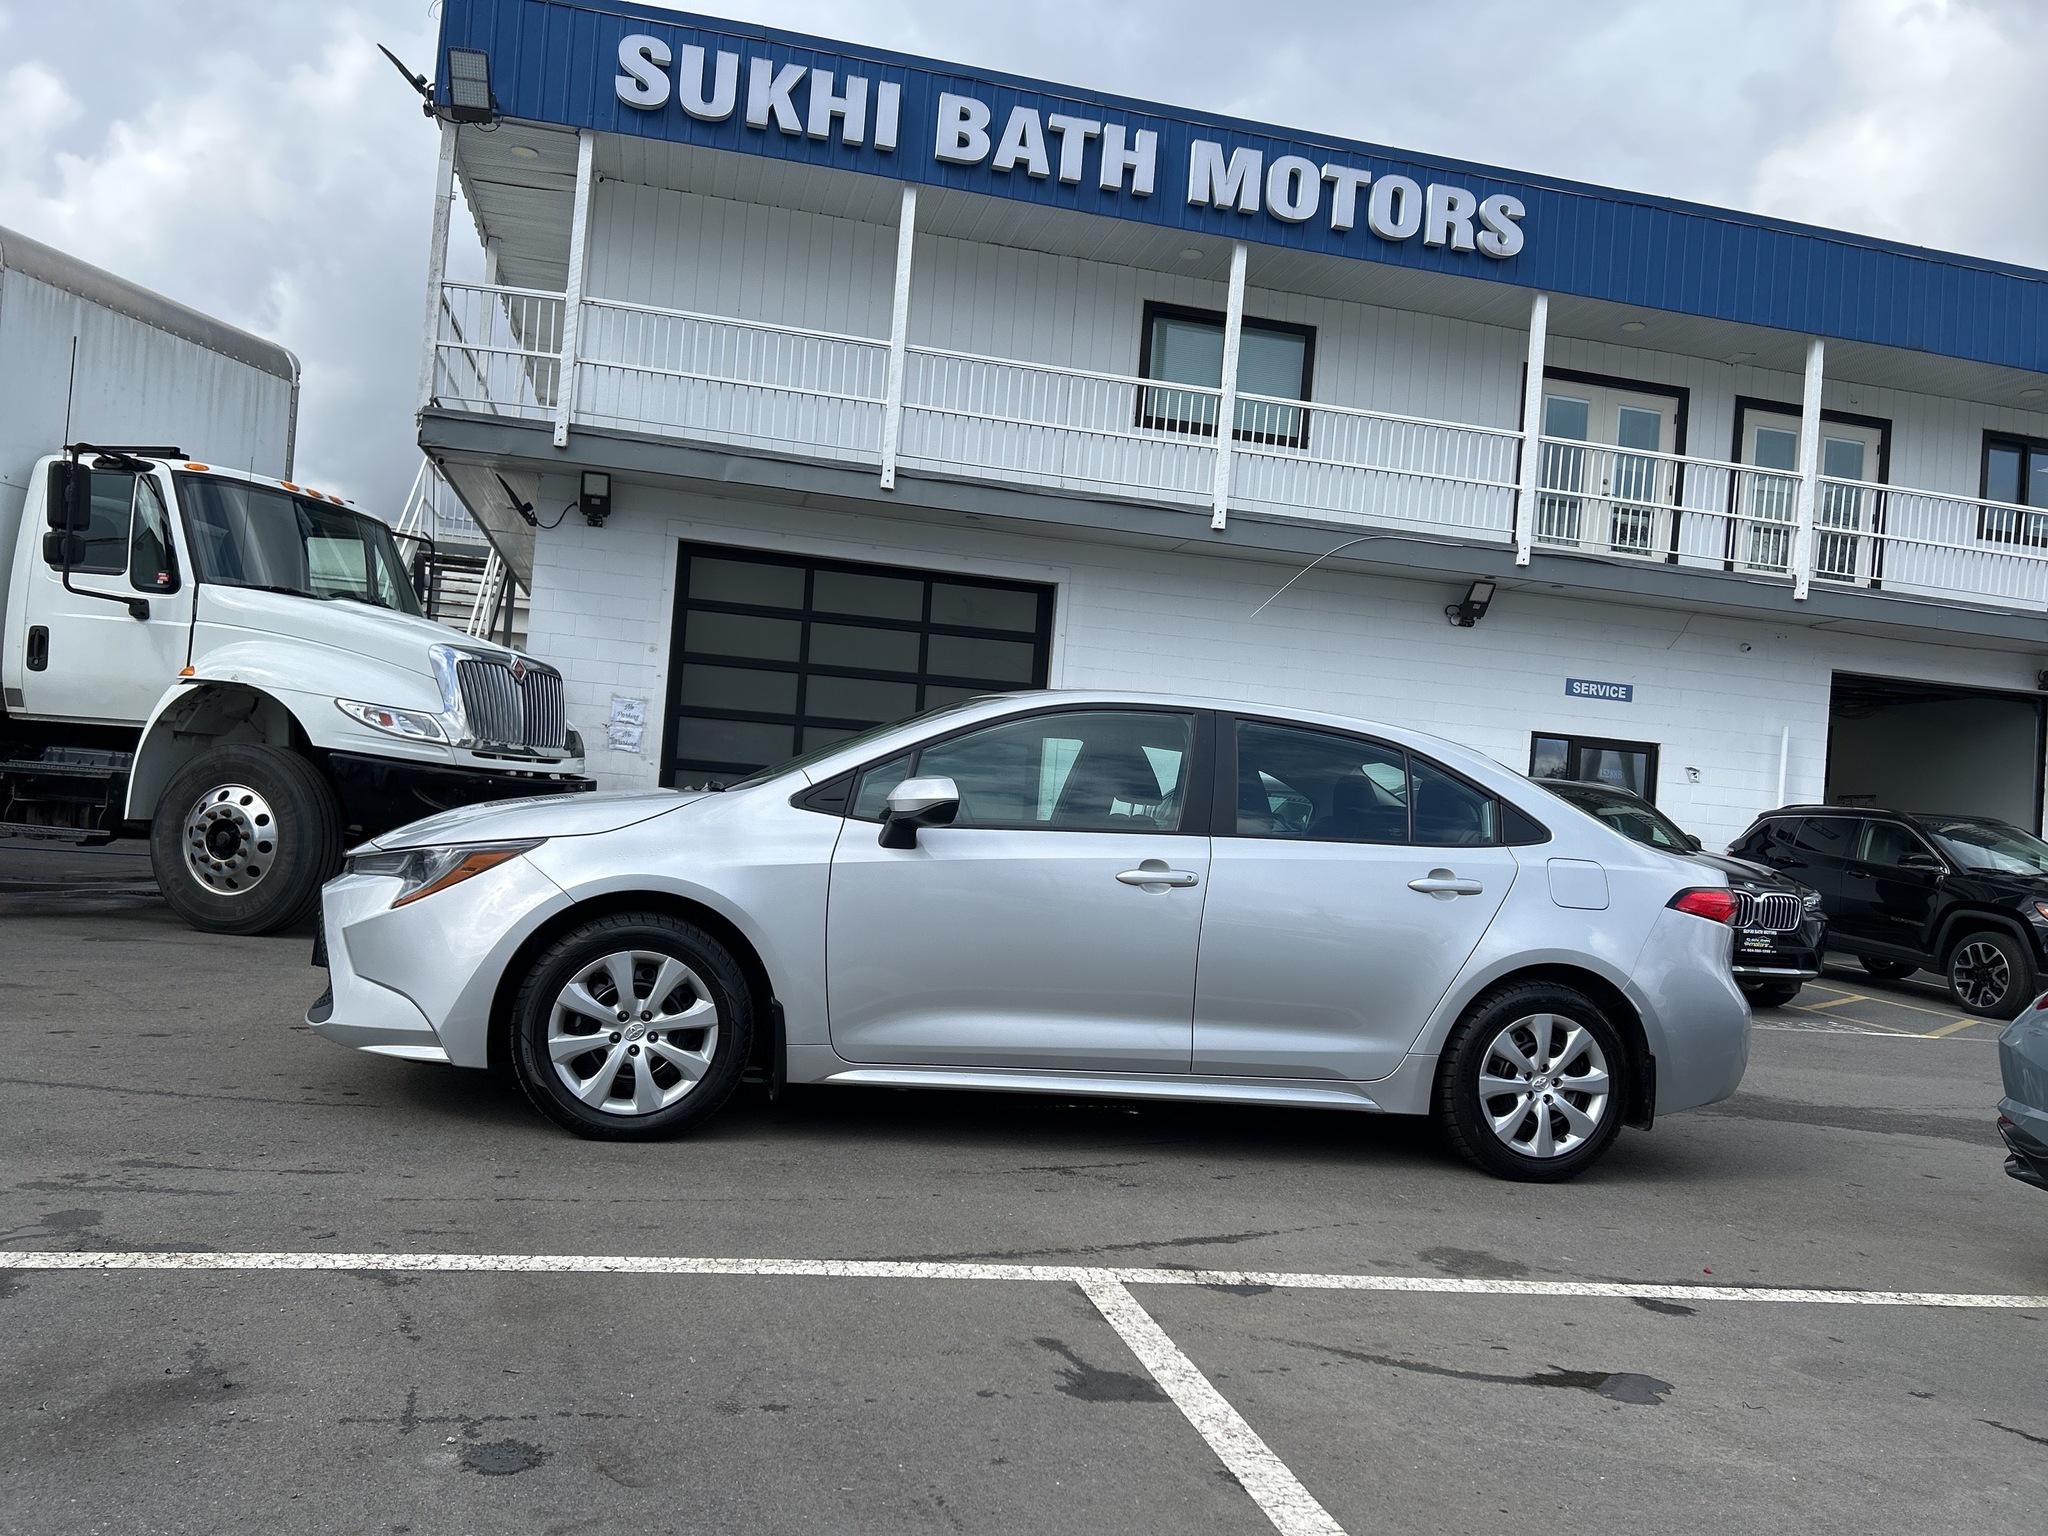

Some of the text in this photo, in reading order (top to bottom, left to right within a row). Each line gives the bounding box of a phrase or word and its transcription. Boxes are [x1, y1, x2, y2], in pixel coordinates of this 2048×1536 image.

[615, 33, 1526, 260] SUKHI BATH MOTORS
[1572, 682, 1627, 698] SERVICE
